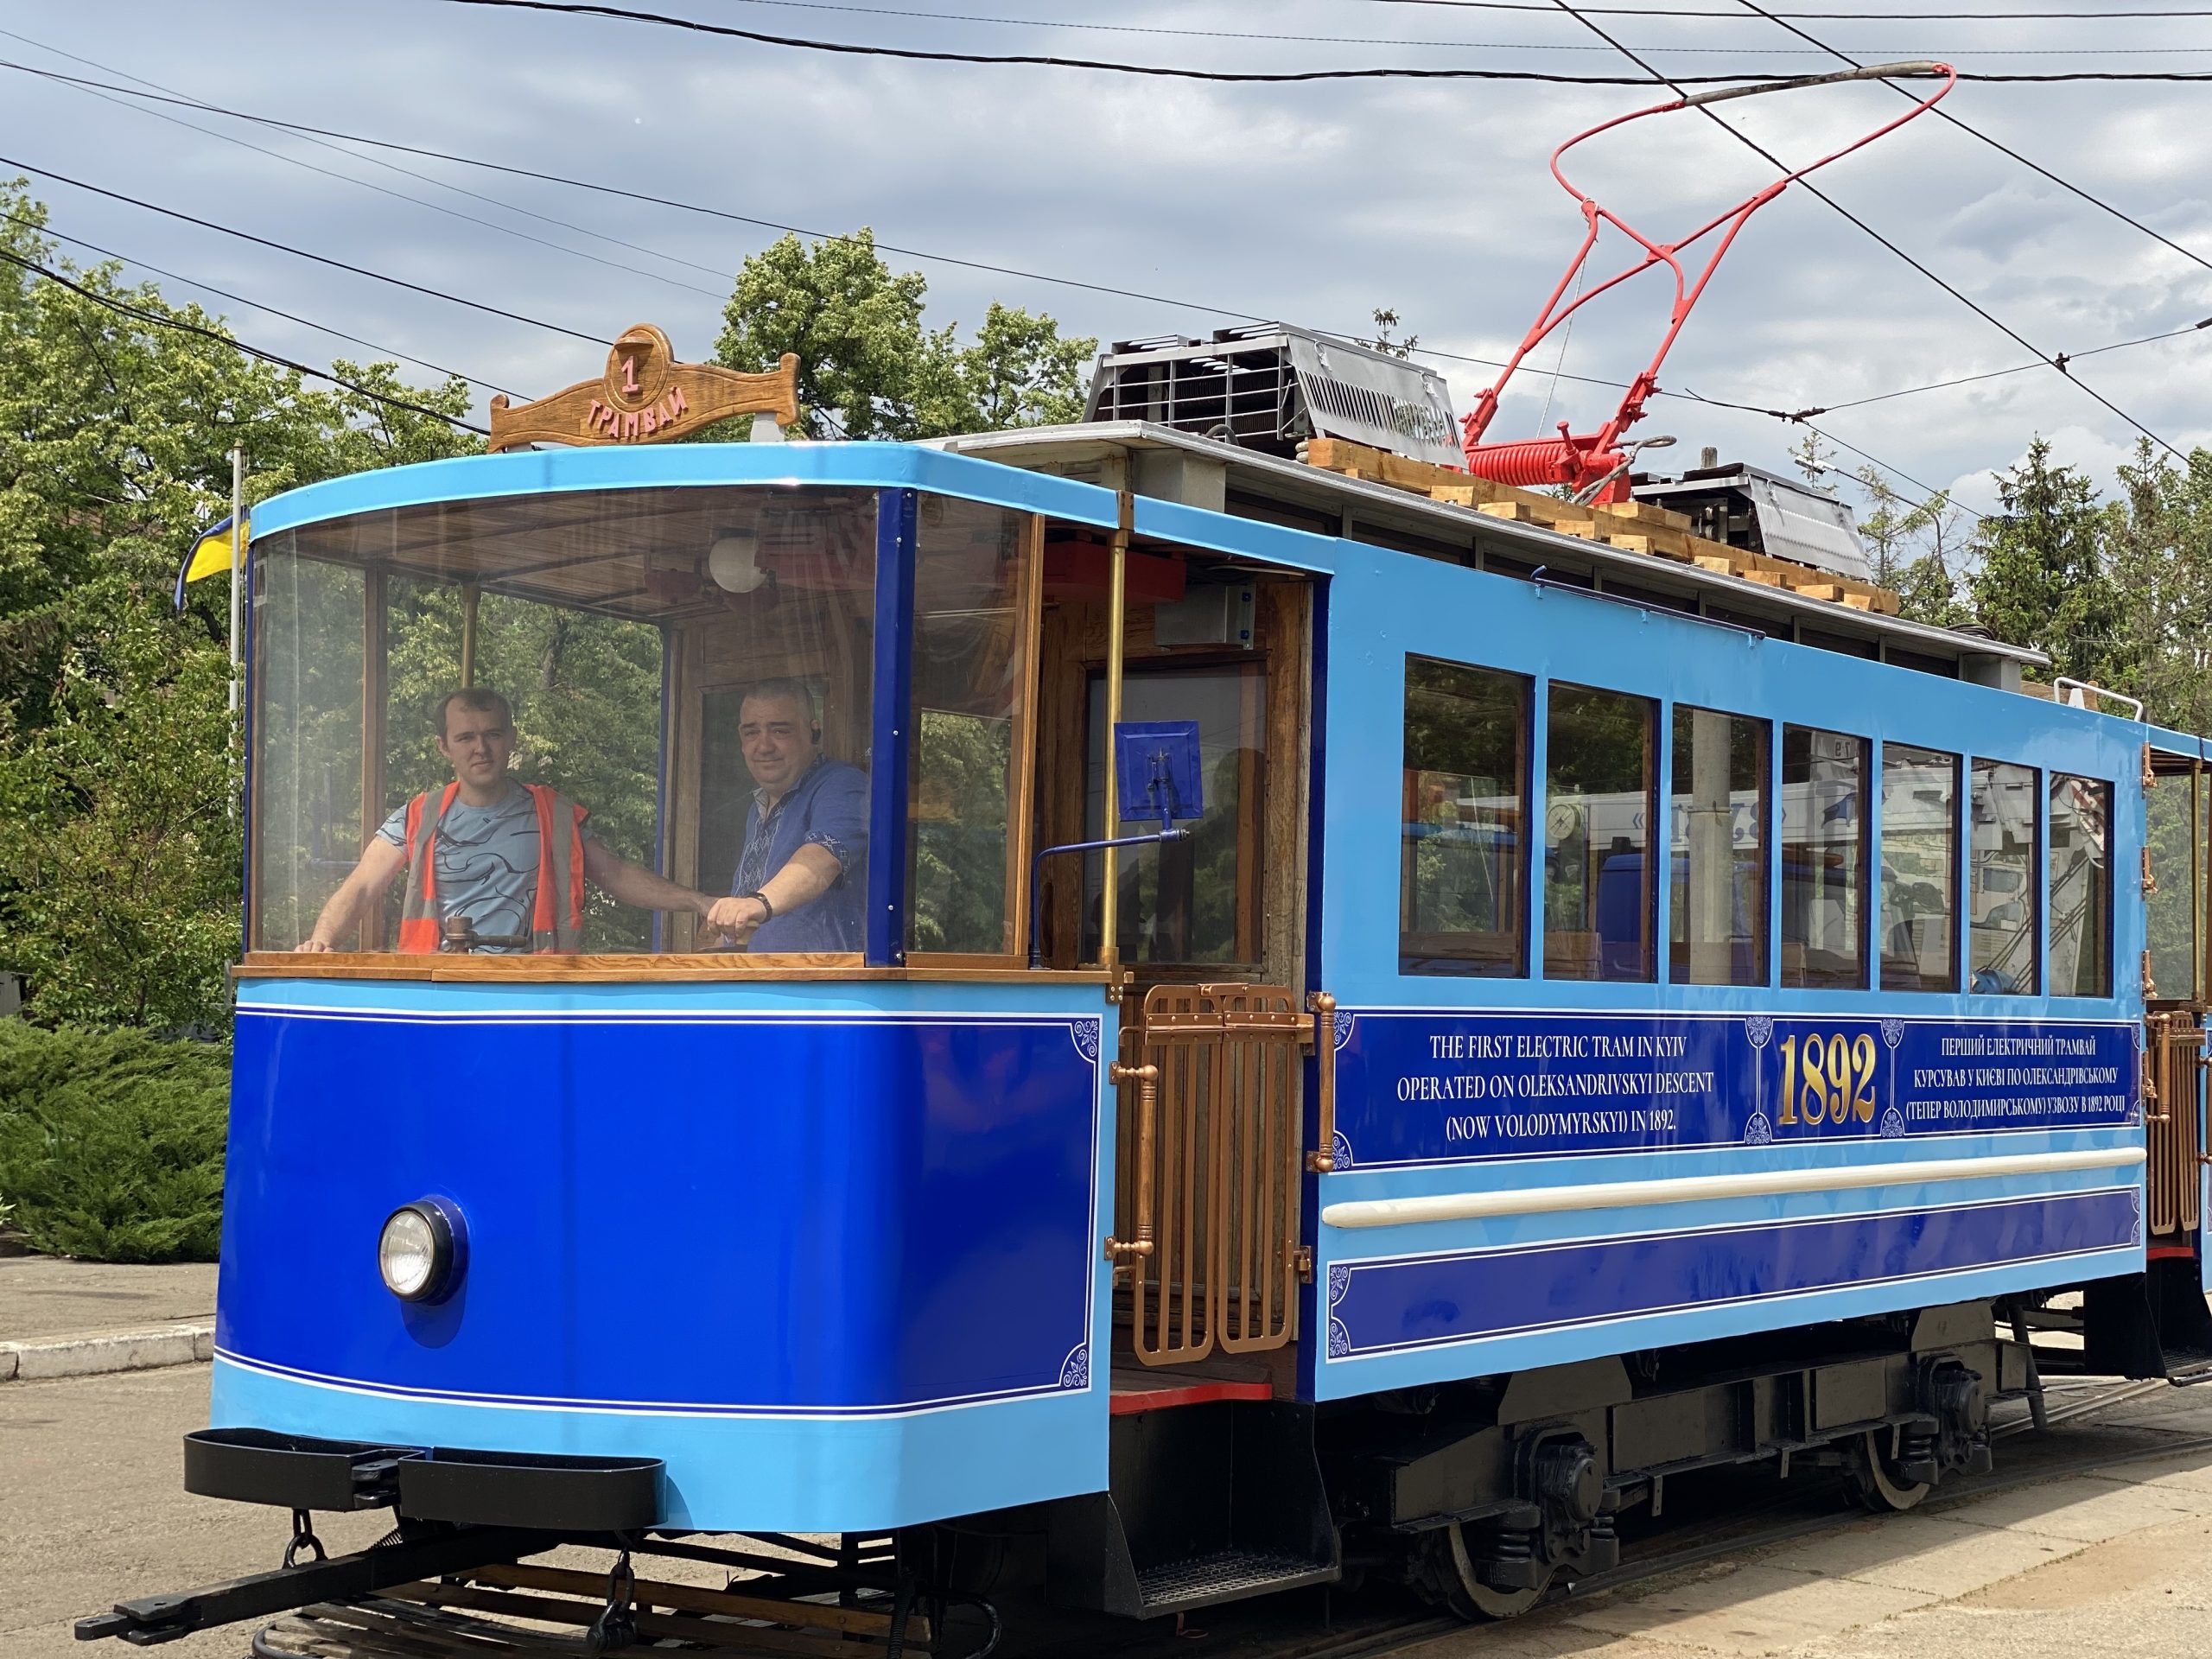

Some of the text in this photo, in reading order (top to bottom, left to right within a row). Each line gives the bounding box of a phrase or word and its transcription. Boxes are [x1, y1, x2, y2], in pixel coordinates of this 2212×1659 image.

[621, 355, 640, 393] 1
[588, 386, 689, 439] ТРАМВАЙ
[1429, 1034, 1688, 1058] THE FIRST ELECTRIC TRAM IN KYIV
[1941, 1033, 2096, 1057] ПЕРШИЙ ЕЛЕКТРИЧНИЙ ТРАМВАЙ
[1397, 1071, 1714, 1102] OPERATED ON OLEKSANDRIVSKYI DESCENT
[1778, 1033, 1877, 1126] 1892
[1914, 1067, 2119, 1089] КУРСУВАВ У КИЄВІ ПО ОЛЕКСАНДРІВСЬКОМУ
[1905, 1095, 2126, 1122] (ТЕПЕР ВОЛОДИМИРСЬКОМУ) УЗВОЗУ В 1892 РОЦІ
[1446, 1109, 1676, 1142] (NOW VOLODYMYRSKYI) IN 1892.
